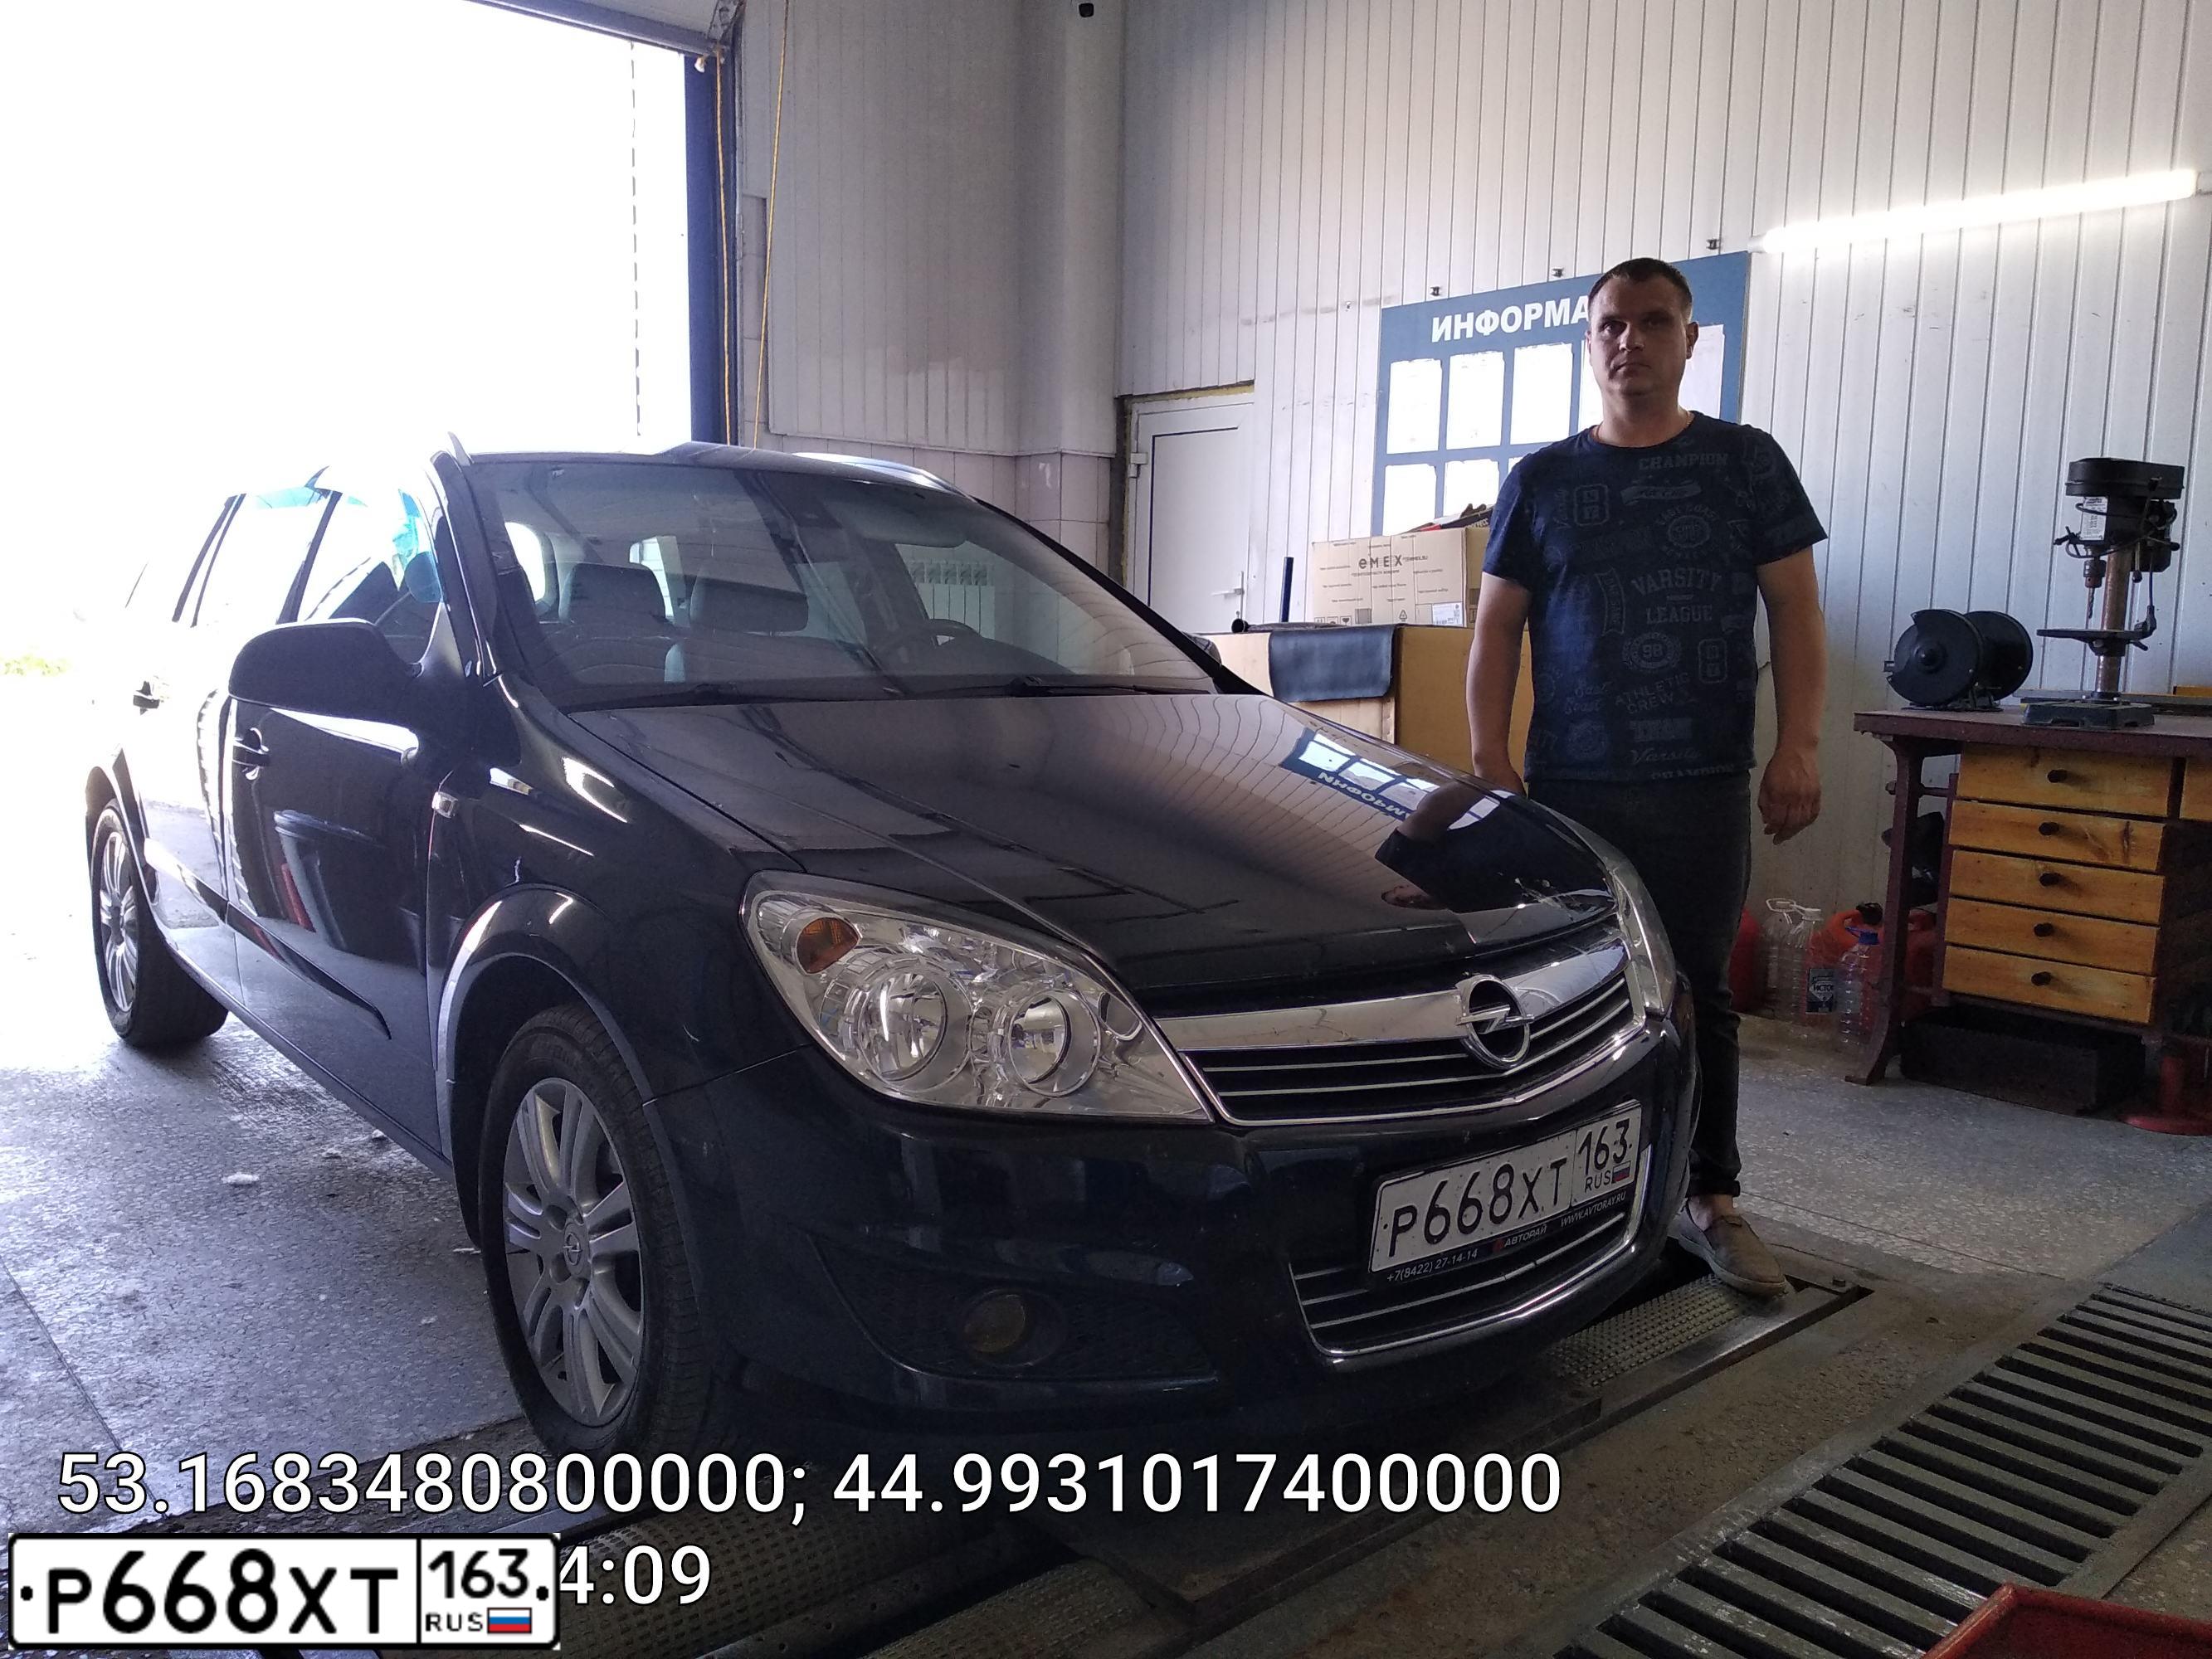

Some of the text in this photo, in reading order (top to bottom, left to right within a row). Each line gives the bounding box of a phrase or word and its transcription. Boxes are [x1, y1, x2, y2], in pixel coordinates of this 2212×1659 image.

[1639, 453, 1728, 470] CHAMPION
[1631, 567, 1722, 596] VARSITY
[1646, 604, 1713, 625] LEAGUE
[1615, 672, 1691, 706] ATHLETIC
[1627, 692, 1674, 714] CREW
[1578, 1118, 1630, 1175] 163
[1584, 1170, 1612, 1193] RUS
[1386, 1191, 1627, 1282] +7(8422) 27-14-14 АВТОРАЙ WWW.AVTORAY.RU
